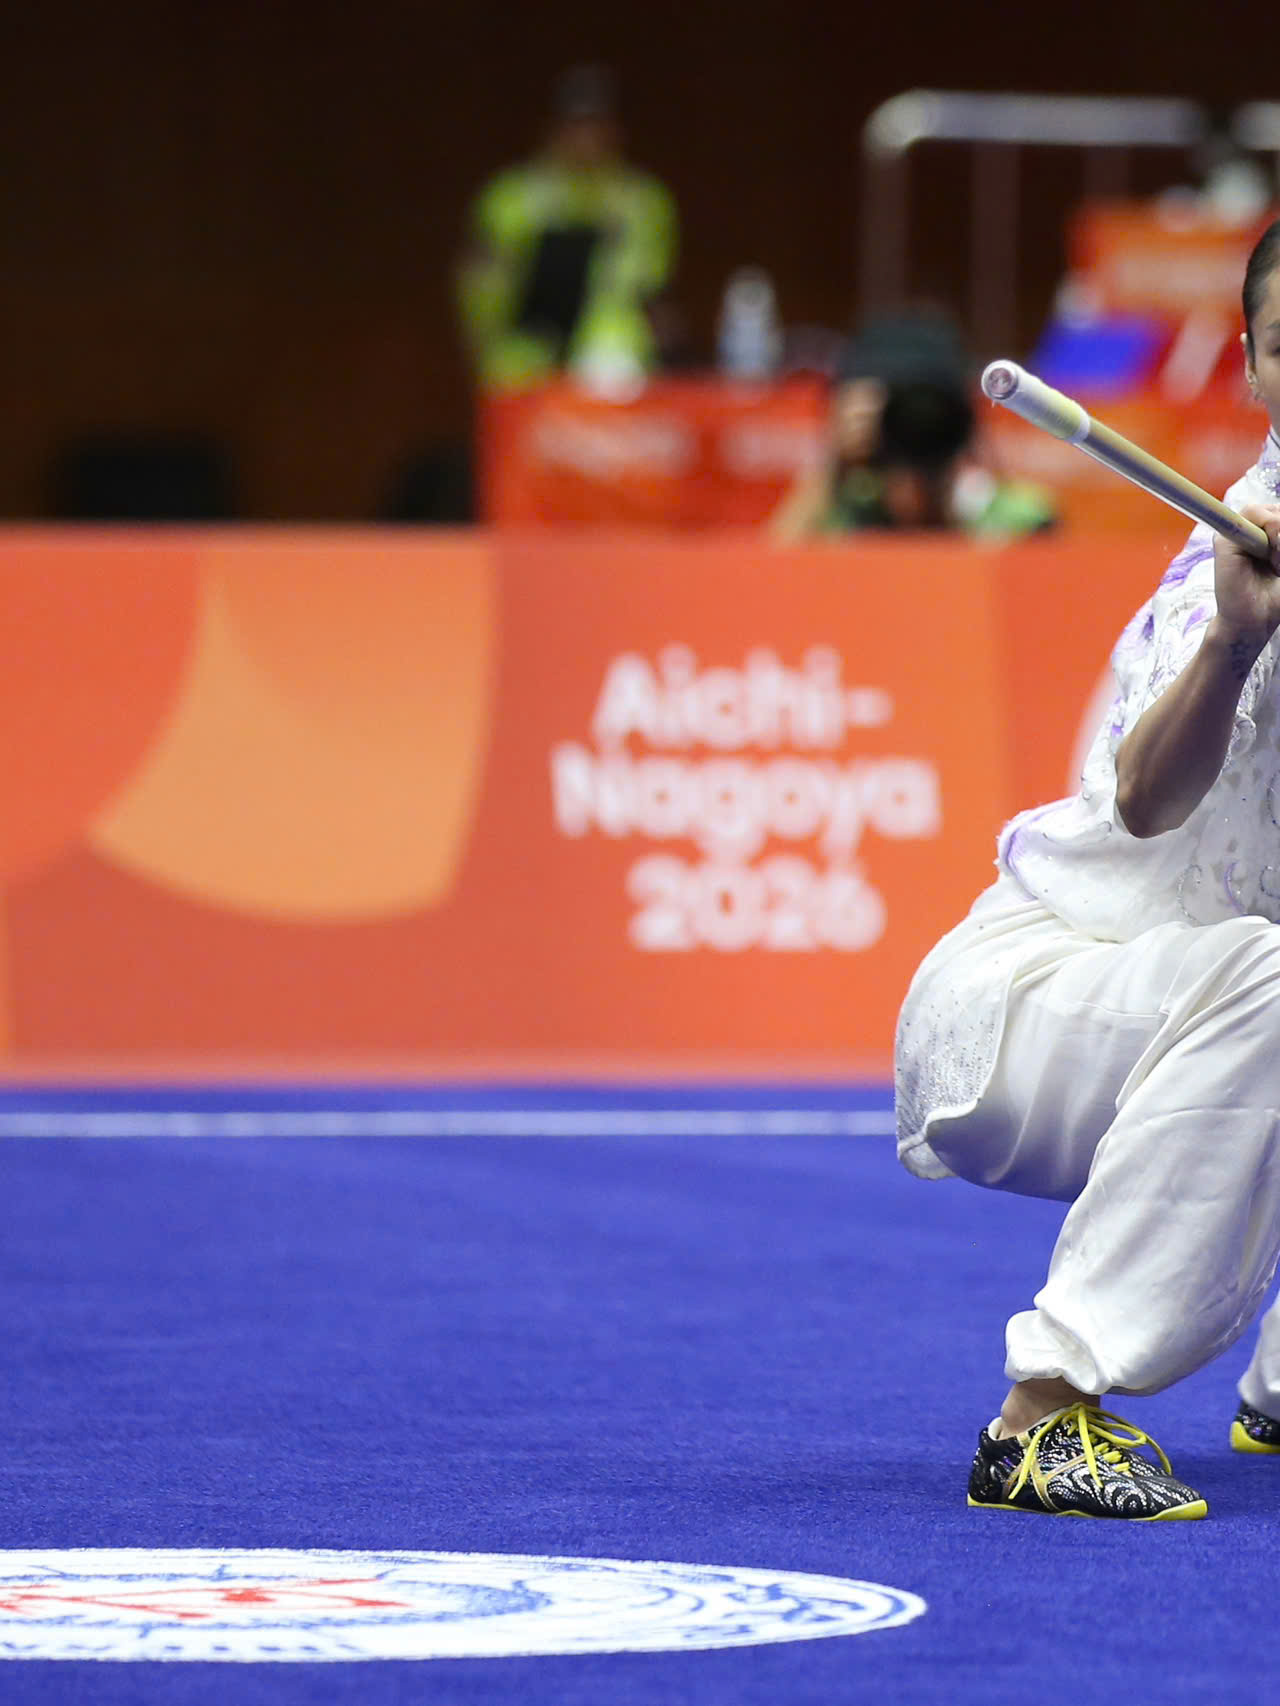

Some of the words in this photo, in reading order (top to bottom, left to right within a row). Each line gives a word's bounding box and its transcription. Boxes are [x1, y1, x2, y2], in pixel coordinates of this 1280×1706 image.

[594, 644, 892, 749] Aichi-
[553, 742, 940, 861] Nagoya
[628, 854, 885, 951] 2026
